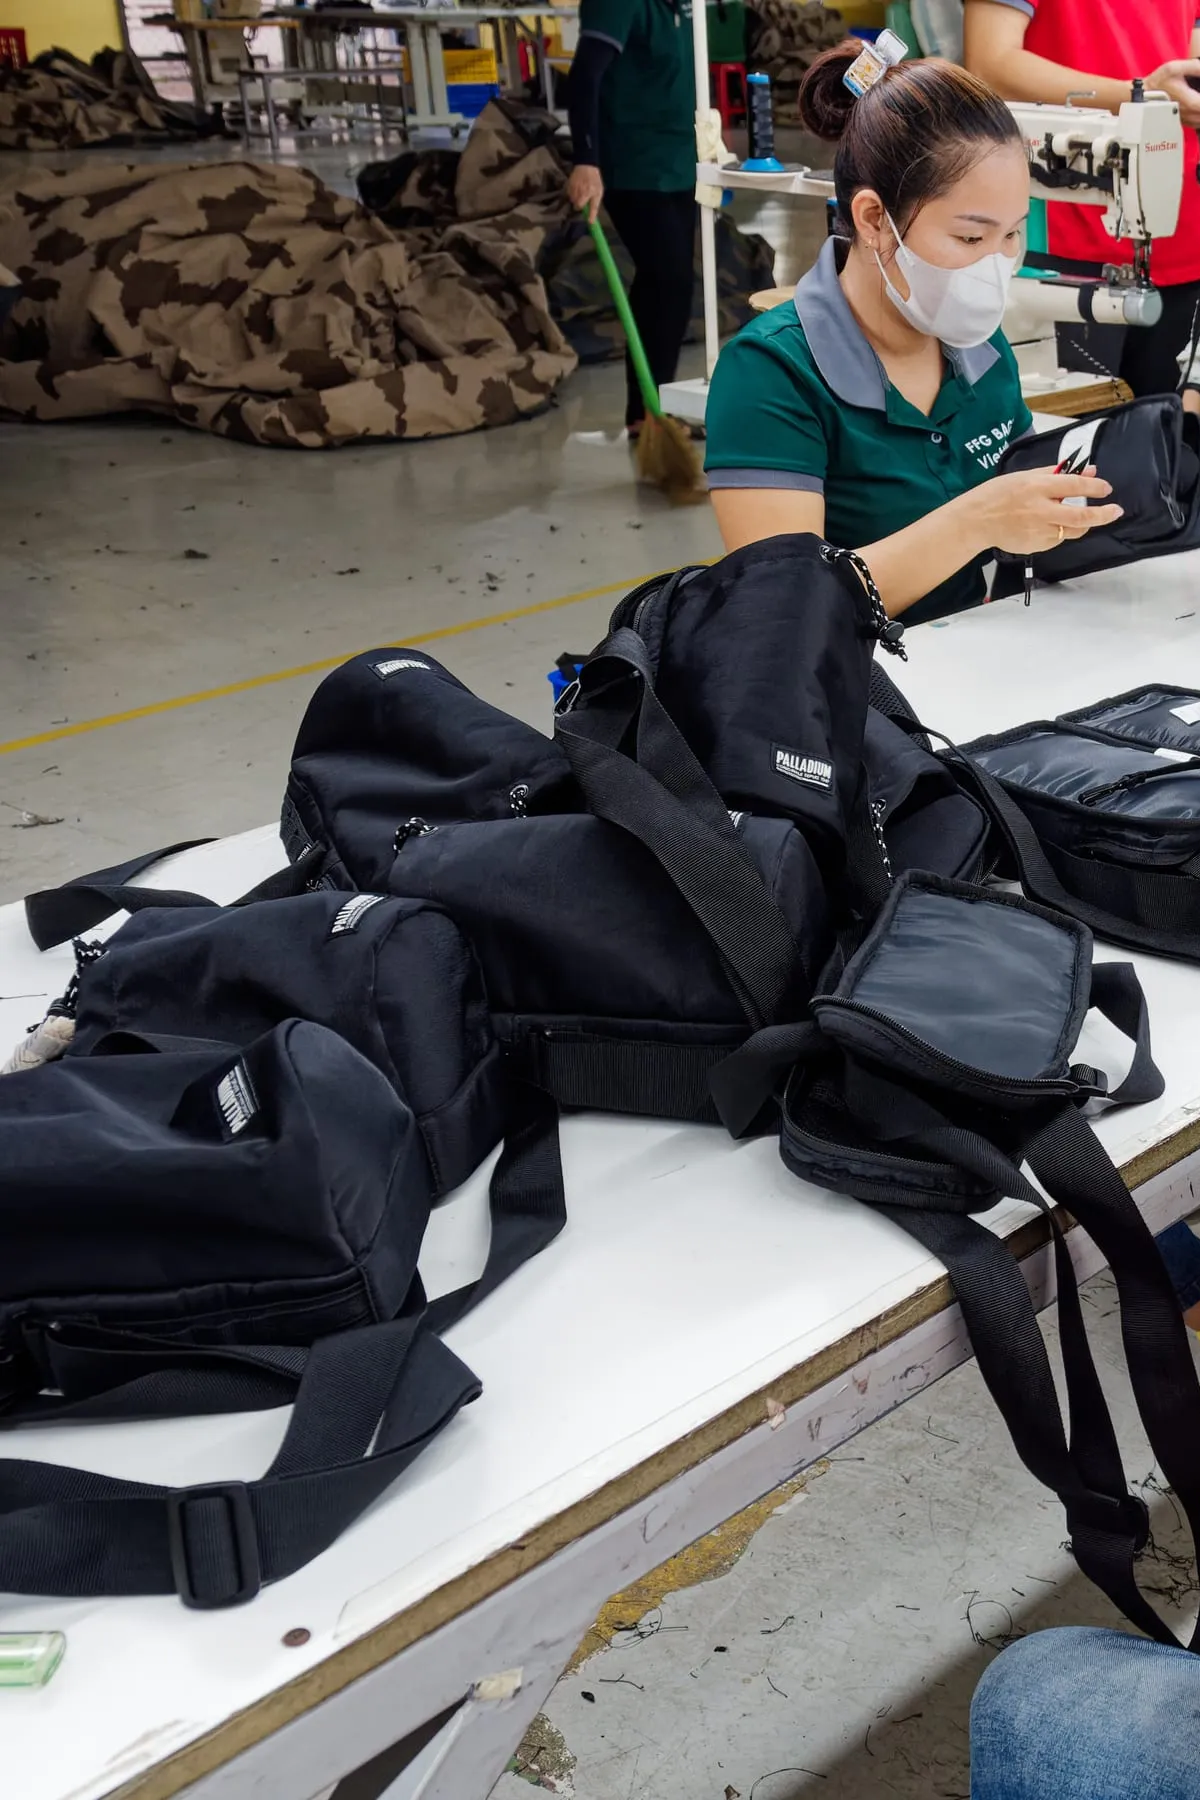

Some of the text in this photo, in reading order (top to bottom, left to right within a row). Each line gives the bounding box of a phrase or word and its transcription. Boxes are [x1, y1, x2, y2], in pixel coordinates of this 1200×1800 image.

[1144, 141, 1178, 153] SunStar
[964, 434, 992, 454] FFG
[776, 750, 832, 779] PALLADIUM
